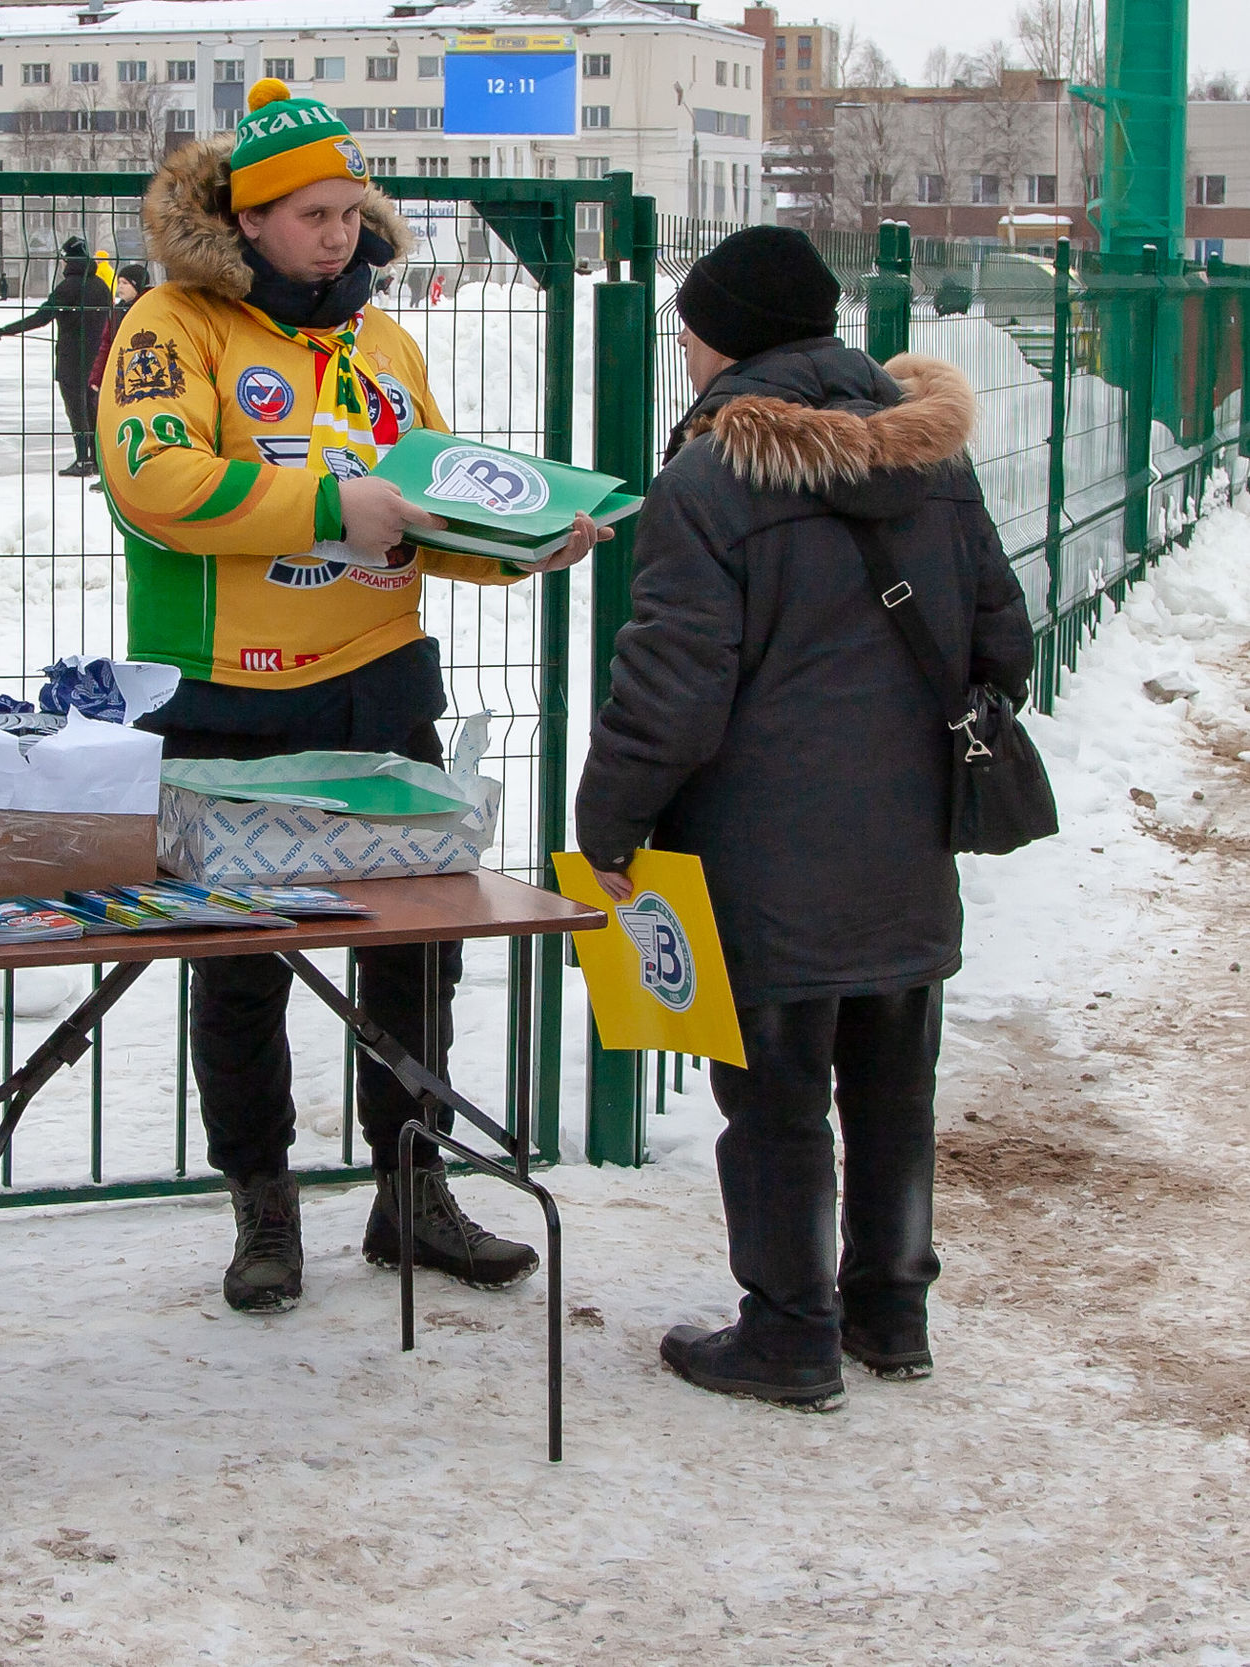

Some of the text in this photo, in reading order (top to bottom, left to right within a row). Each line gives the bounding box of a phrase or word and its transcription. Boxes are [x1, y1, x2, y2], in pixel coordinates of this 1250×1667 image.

[116, 412, 194, 480] 29
[212, 811, 240, 836] sappi
[240, 805, 269, 827] sappi
[244, 822, 270, 850] sappi
[324, 820, 351, 847] sappi
[279, 838, 305, 867] sappi
[332, 847, 357, 871] sappi
[358, 834, 384, 862] sappi
[387, 846, 412, 869] sappi
[434, 847, 460, 874] sappi
[231, 855, 258, 880] sappi
[252, 849, 280, 876] sappi
[310, 851, 334, 876] sappi
